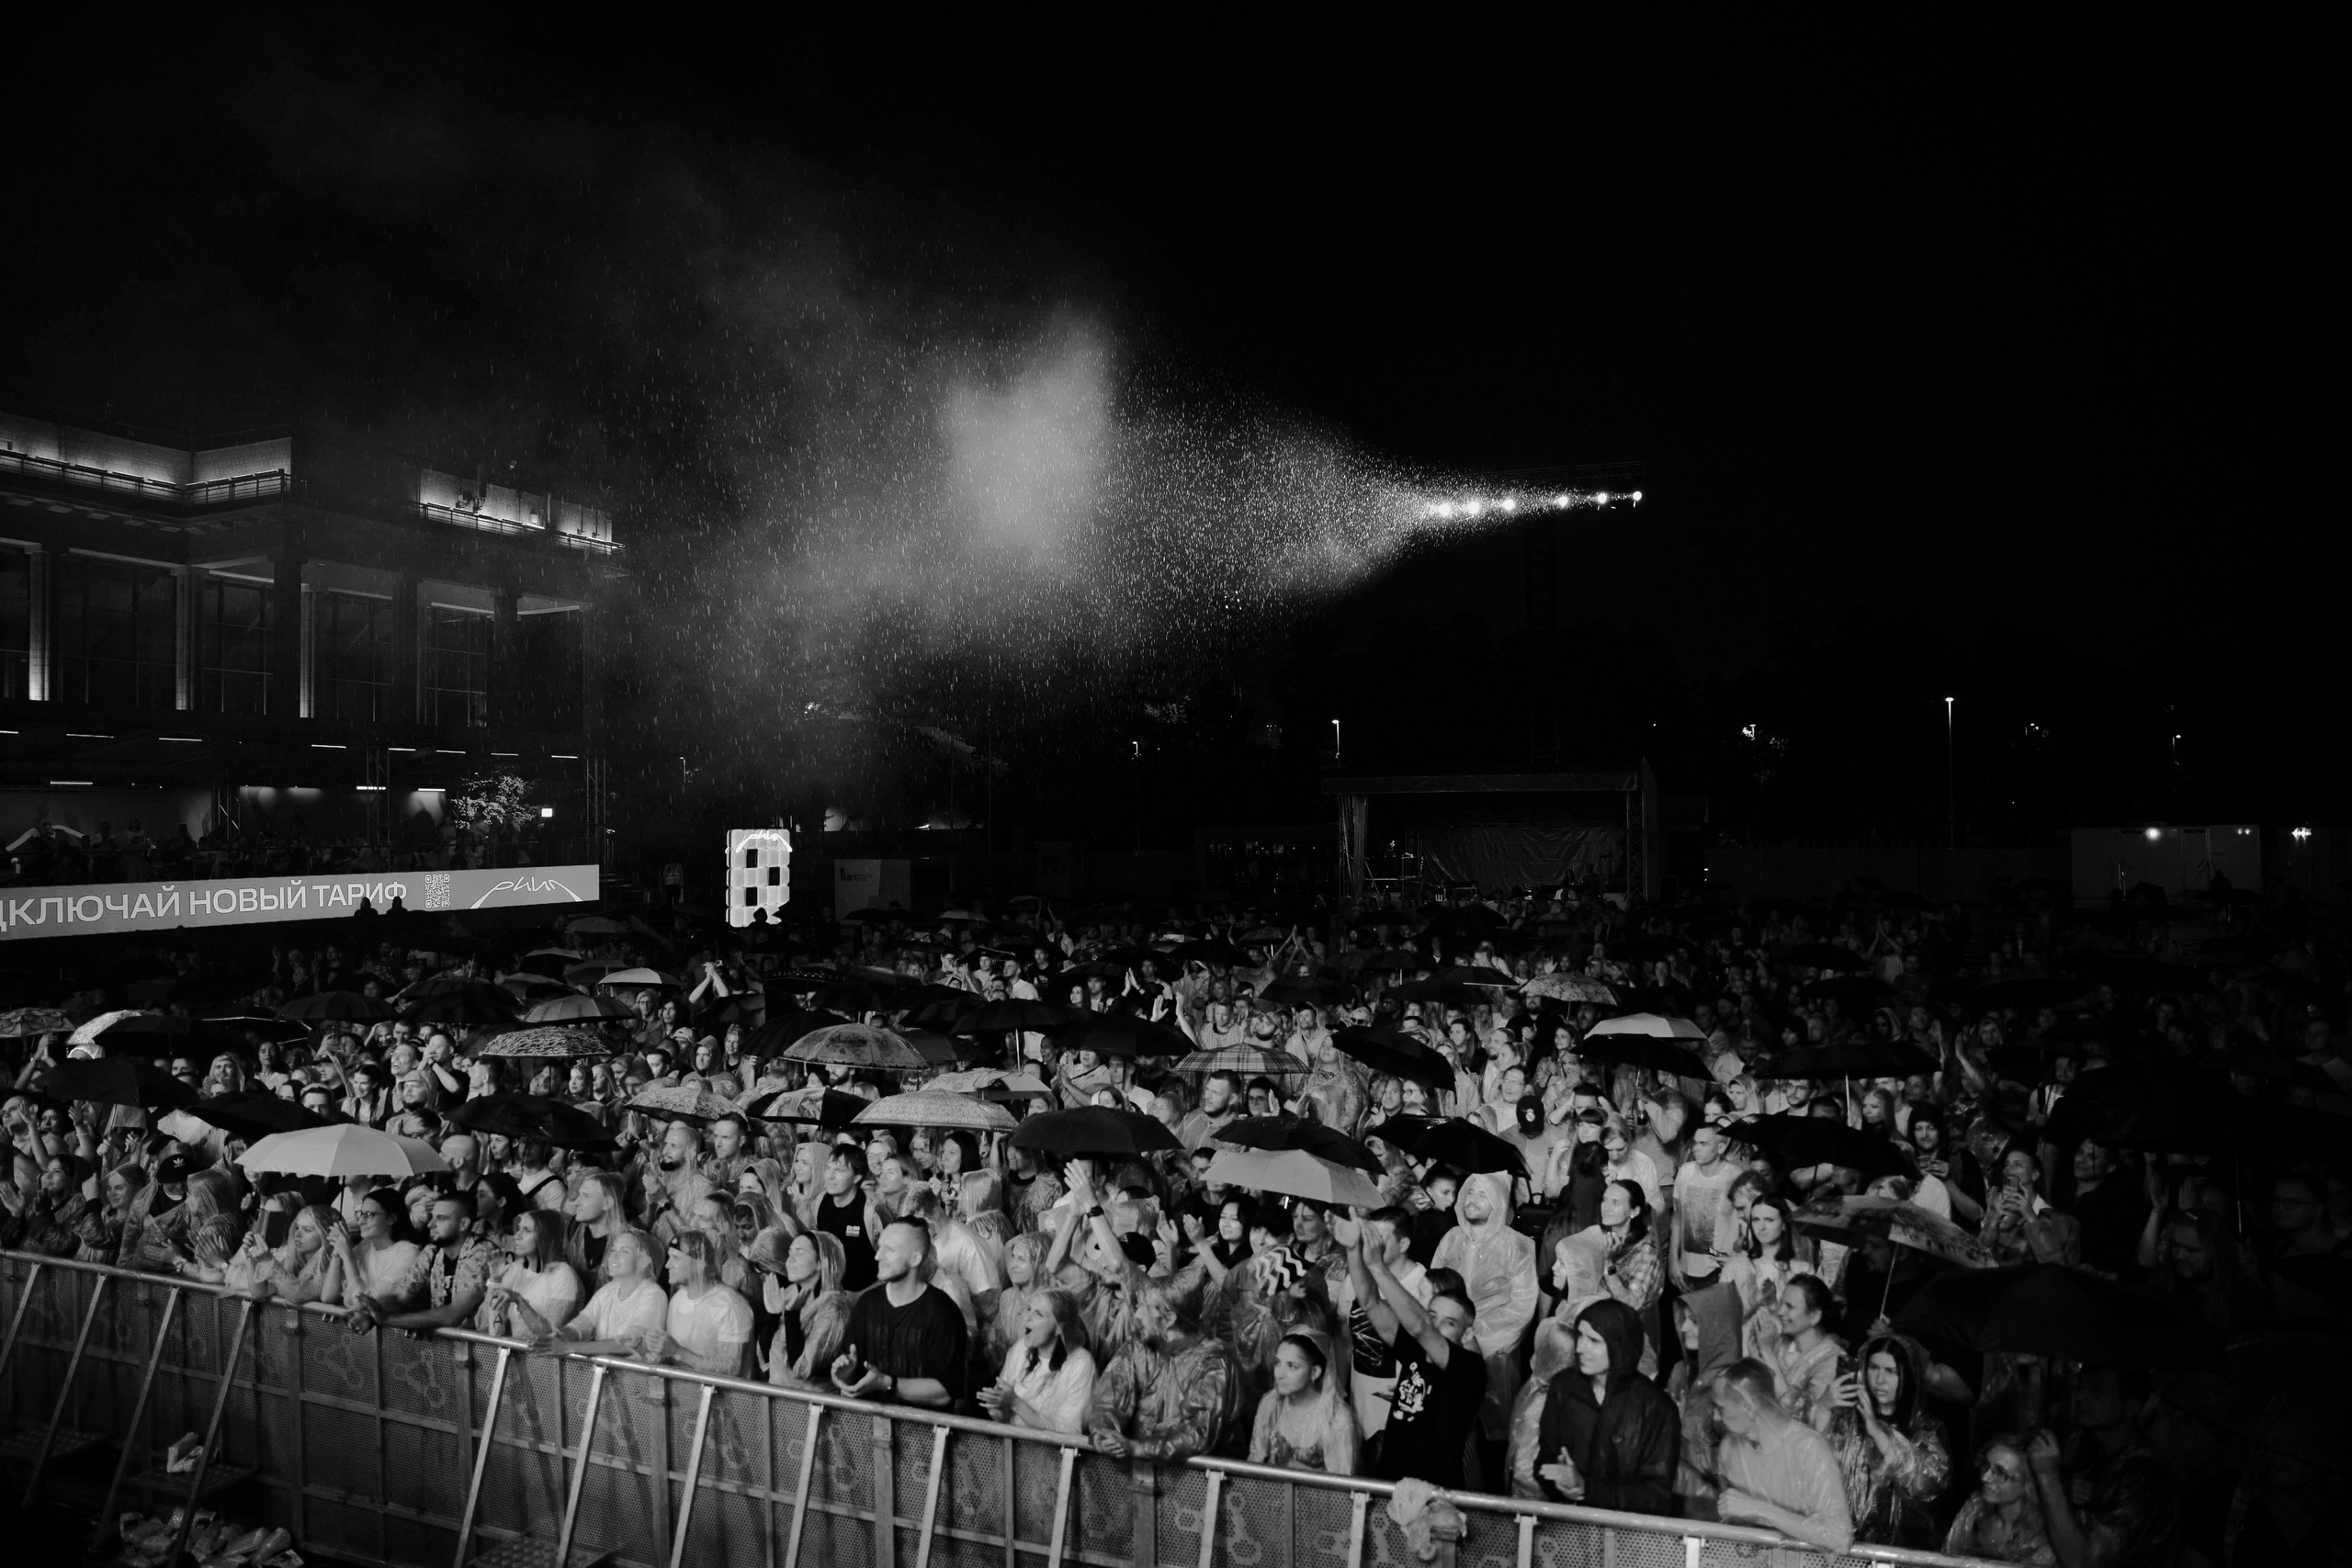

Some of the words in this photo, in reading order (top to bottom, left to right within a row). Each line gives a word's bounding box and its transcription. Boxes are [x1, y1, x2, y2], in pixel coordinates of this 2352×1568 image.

[0, 885, 180, 932] КЛЮЧАЙ
[189, 879, 307, 916] НОВЫЙ
[311, 881, 407, 908] ТАРИФ
